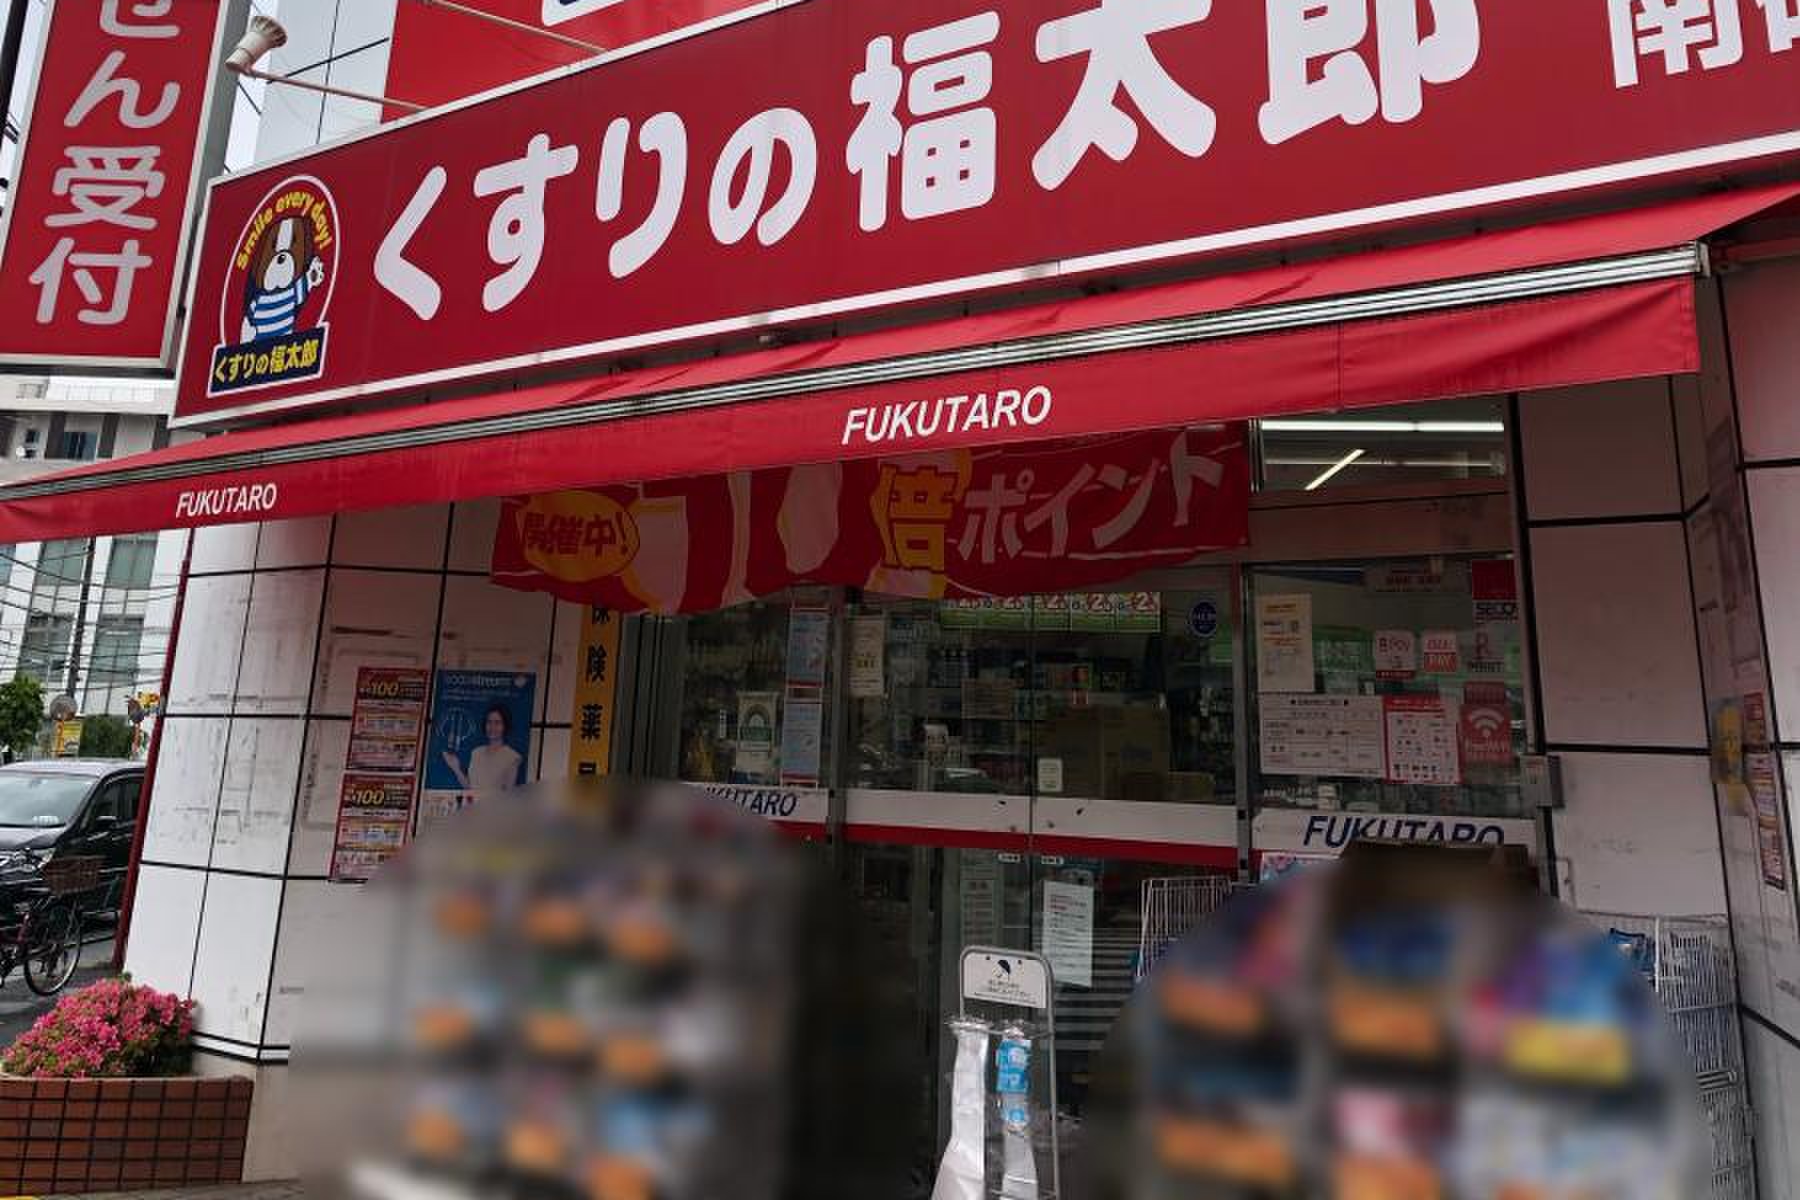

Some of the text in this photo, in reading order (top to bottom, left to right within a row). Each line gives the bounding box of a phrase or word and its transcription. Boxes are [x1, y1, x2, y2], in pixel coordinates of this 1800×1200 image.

[215, 339, 319, 383] くすりの福太郎
[841, 385, 1052, 445] FUKUTARO
[175, 483, 277, 518] FUKUTARO
